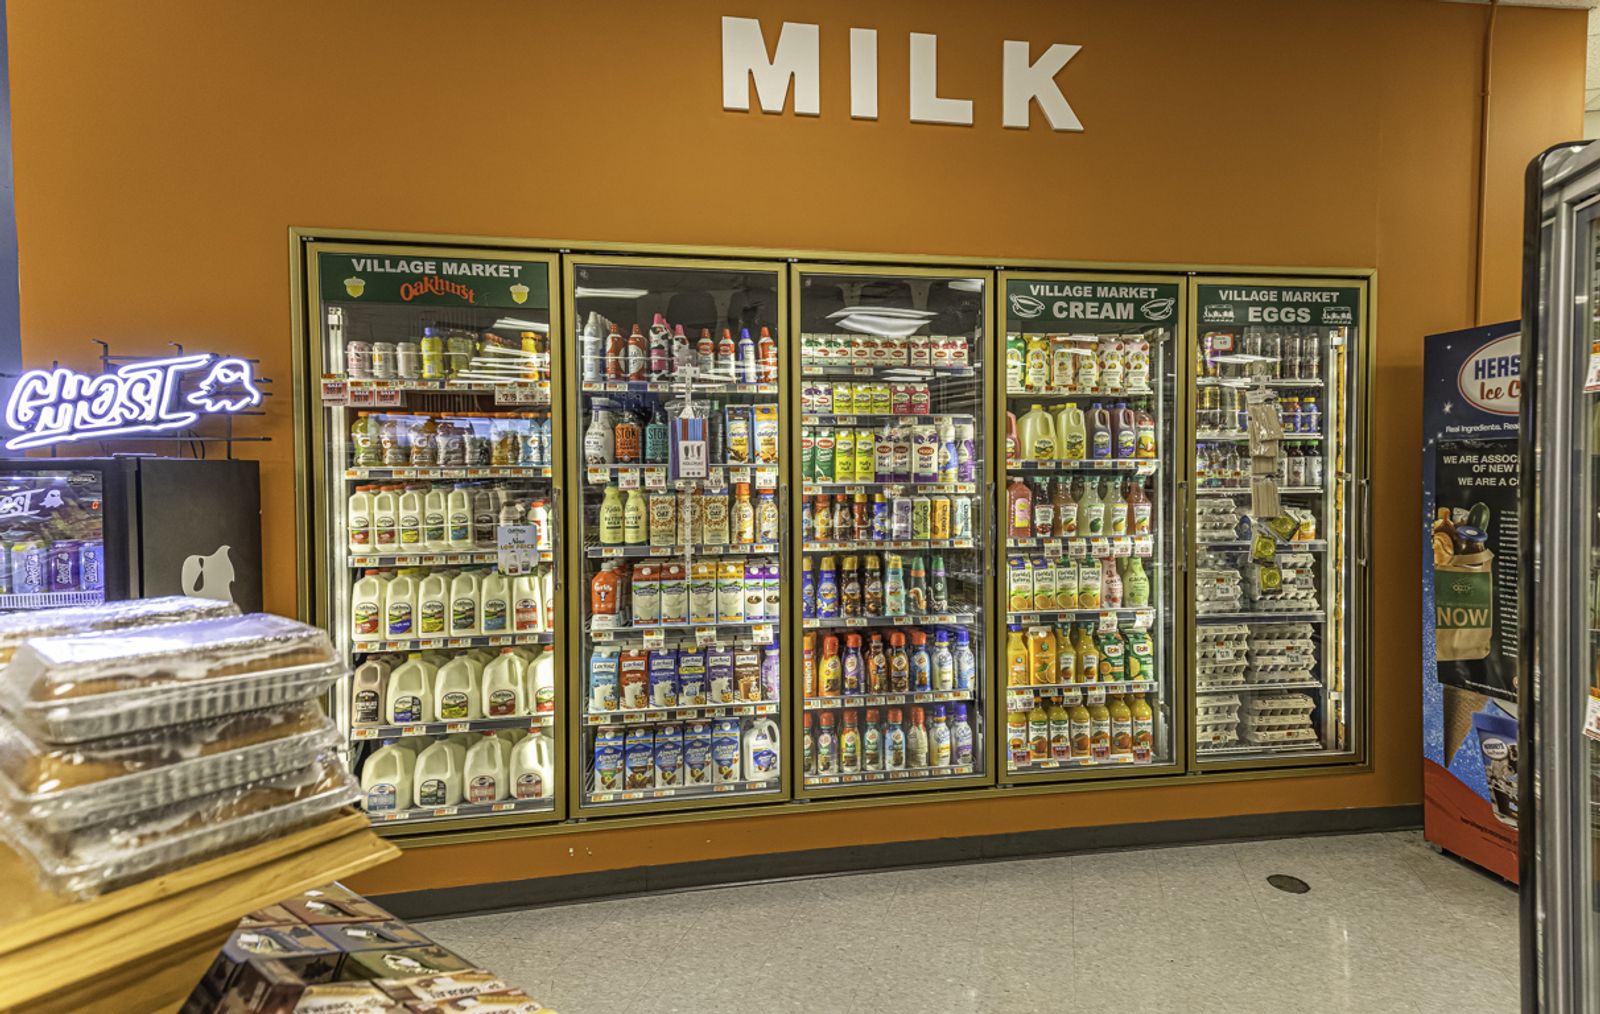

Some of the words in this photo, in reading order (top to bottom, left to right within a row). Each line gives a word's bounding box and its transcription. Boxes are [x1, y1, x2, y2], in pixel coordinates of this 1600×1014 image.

[721, 15, 1084, 132] MILK
[351, 258, 437, 275] VILLAGE
[442, 262, 522, 279] MARKET
[400, 275, 475, 304] Oakhurst
[1029, 284, 1092, 298] VILLAGE
[1096, 286, 1158, 300] MARKET
[1218, 289, 1278, 302] VILLAGE
[1281, 291, 1339, 303] MARKET
[1052, 301, 1134, 320] CREAM
[1247, 306, 1311, 323] EGGS
[1480, 381, 1504, 400] Ice
[1445, 425, 1460, 433] Real
[1461, 424, 1502, 434] Ingredients.
[1443, 455, 1458, 464] WE
[1459, 455, 1479, 464] ARE
[1480, 454, 1520, 464] ASSOC
[1472, 464, 1487, 473] OF
[1488, 464, 1514, 473] NEW
[1457, 477, 1473, 486] WE
[1475, 477, 1497, 486] ARE
[1498, 477, 1507, 486] A
[1437, 607, 1489, 627] NOW
